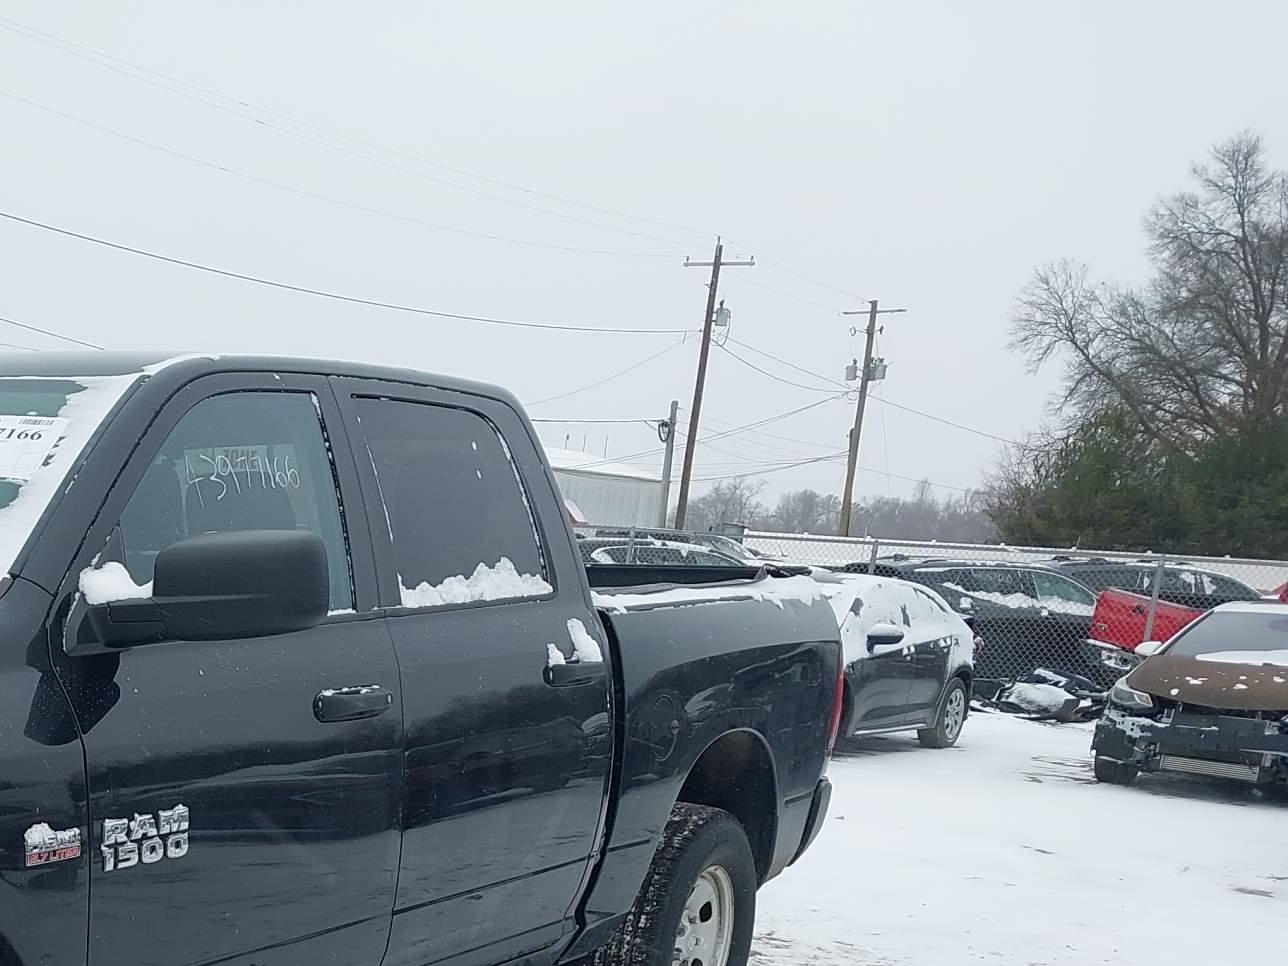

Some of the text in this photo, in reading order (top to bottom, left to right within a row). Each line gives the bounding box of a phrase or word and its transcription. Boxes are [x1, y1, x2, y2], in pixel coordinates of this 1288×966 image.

[185, 453, 300, 508] 43977166
[103, 803, 190, 845] RAM
[101, 832, 189, 872] 1500
